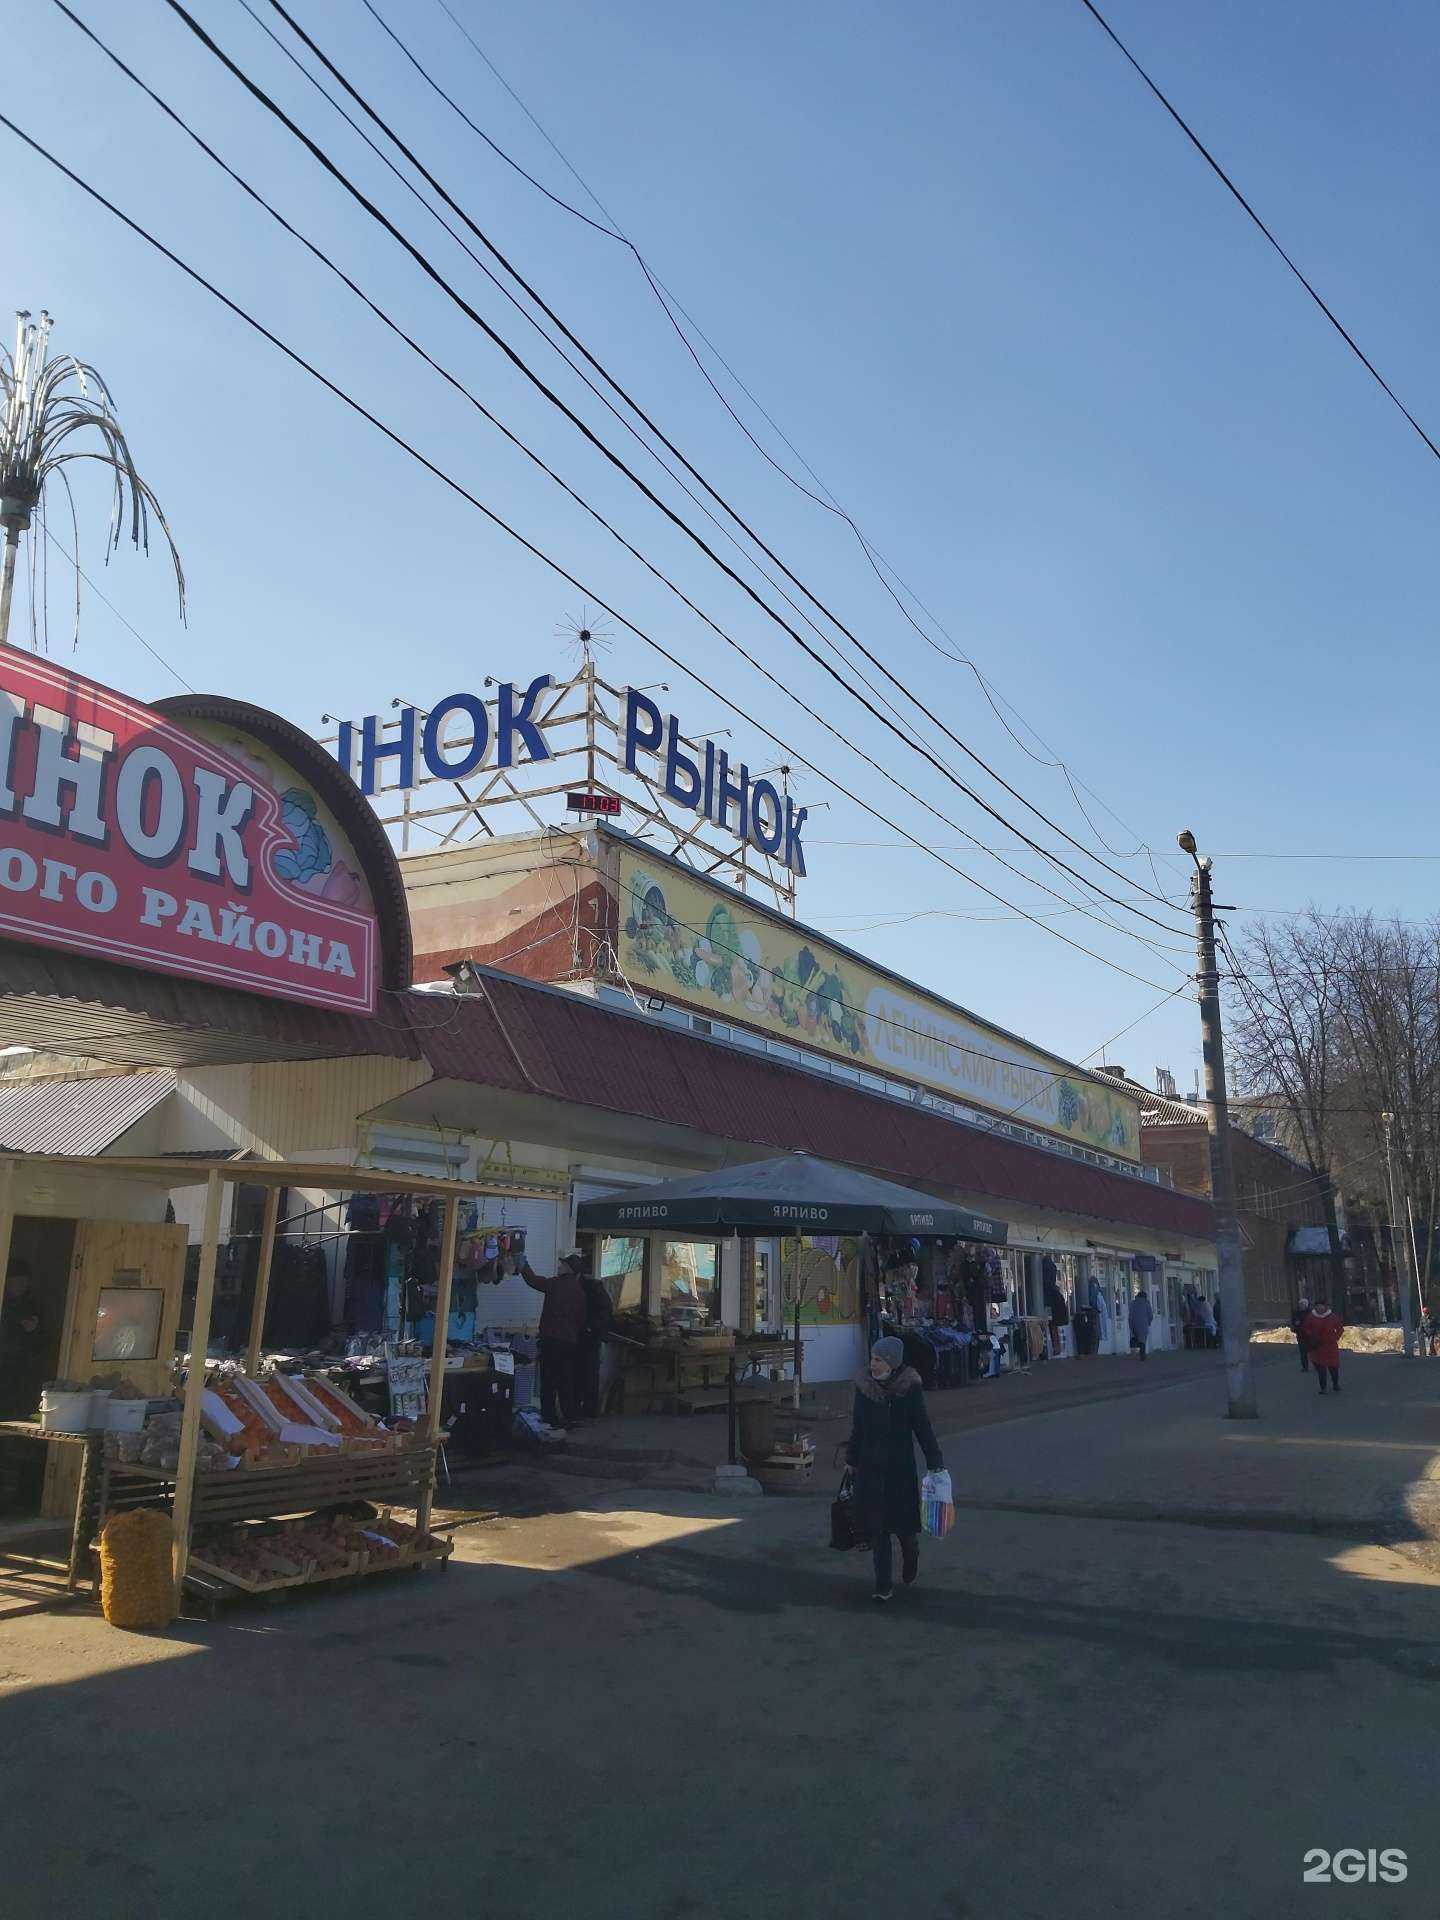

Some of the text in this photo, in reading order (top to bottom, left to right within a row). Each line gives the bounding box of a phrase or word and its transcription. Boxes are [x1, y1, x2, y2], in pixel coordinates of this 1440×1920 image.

[616, 686, 808, 877] РЫНОК
[140, 887, 356, 978] РАЙОНА
[874, 1002, 1056, 1115] ЛЕНИНСКИЙ РЫНОК
[618, 1205, 668, 1219] ЯРПИВО
[773, 1205, 828, 1220] ЯРПИВО
